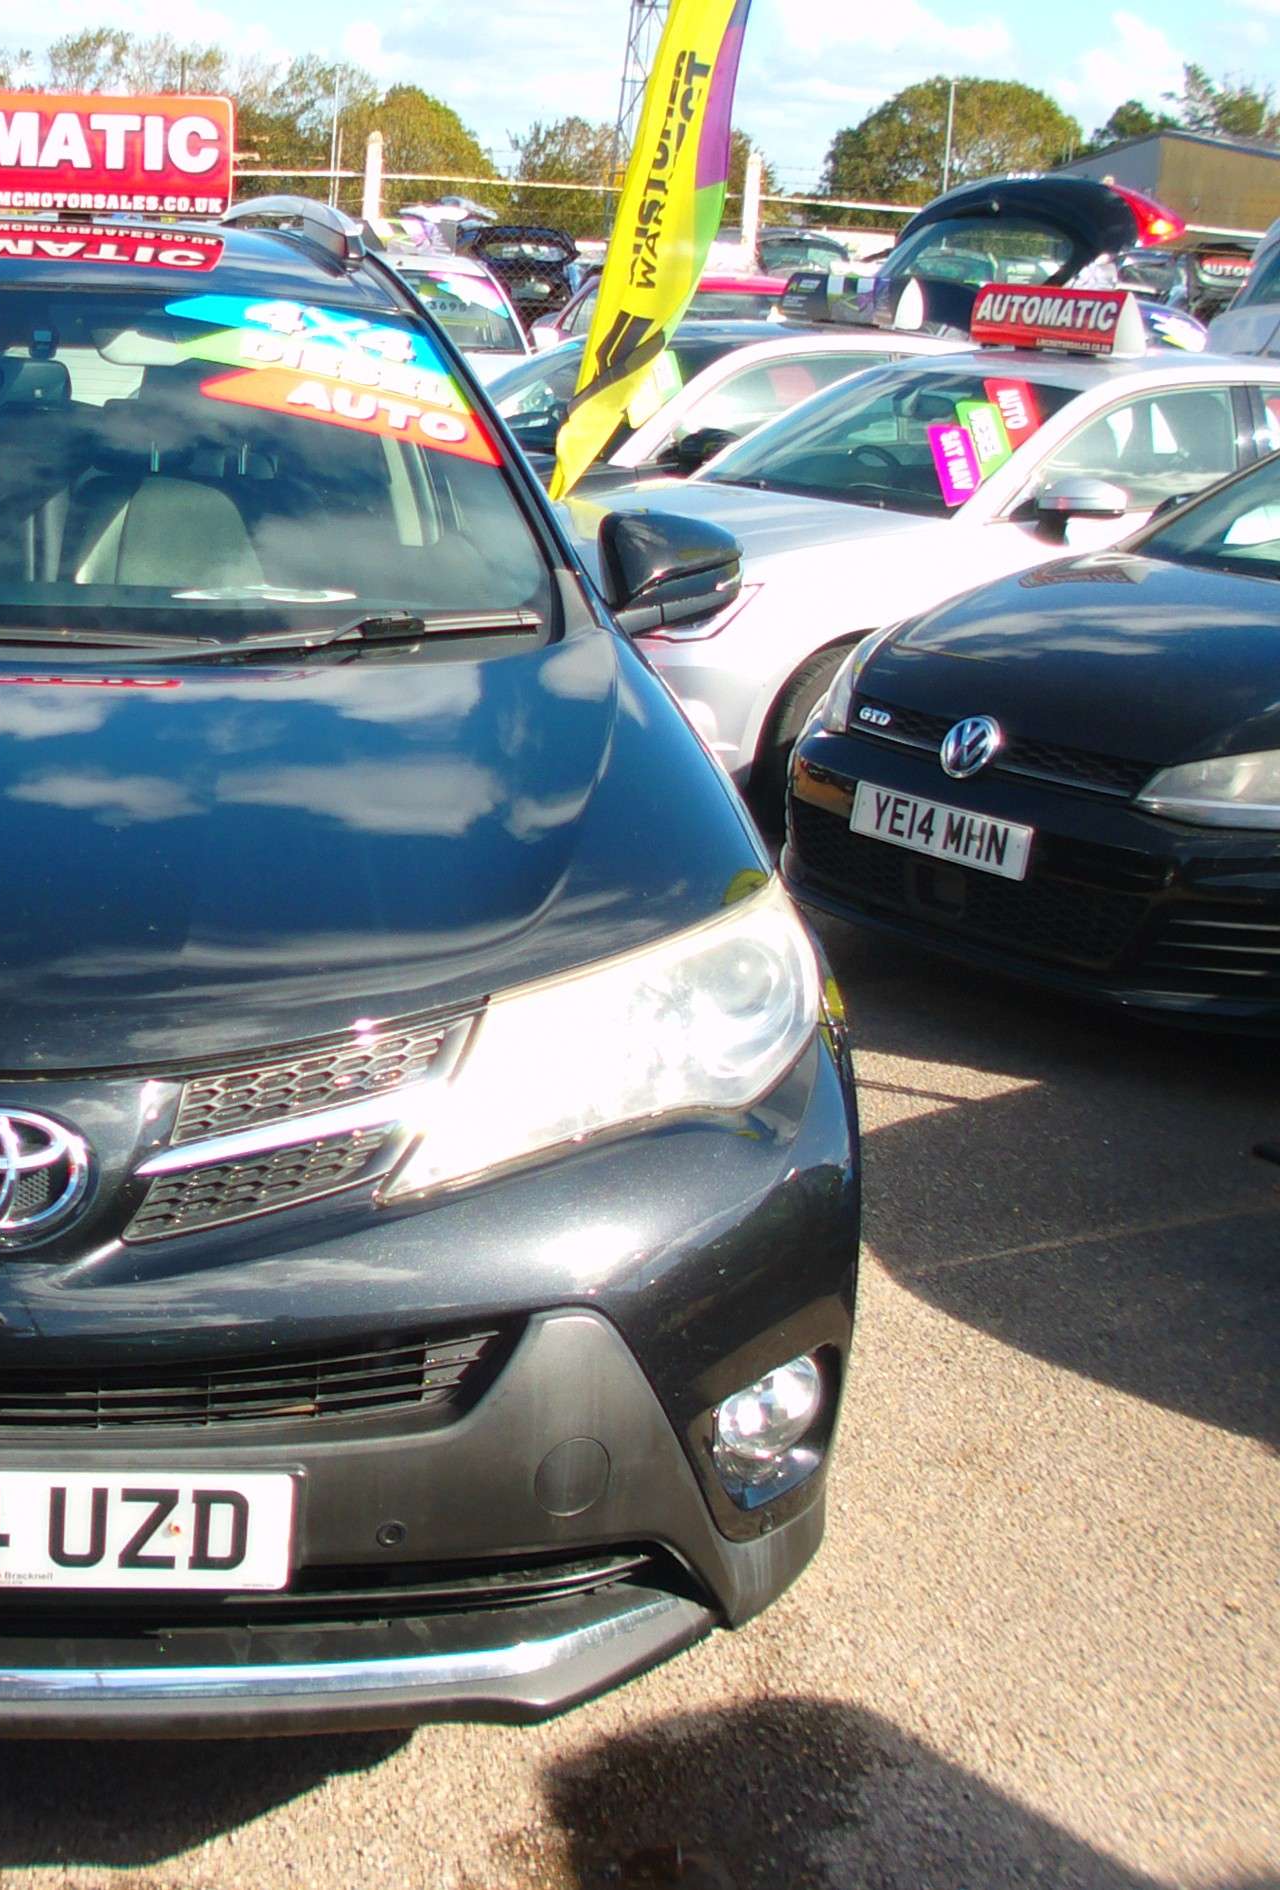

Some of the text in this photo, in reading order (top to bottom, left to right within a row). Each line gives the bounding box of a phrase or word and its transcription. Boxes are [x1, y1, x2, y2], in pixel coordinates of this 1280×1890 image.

[975, 293, 1117, 332] AUTOMATIC
[285, 380, 466, 442] AUTO
[996, 389, 1029, 430] AUTO
[947, 458, 975, 490] NAV
[859, 706, 891, 727] GTD
[875, 791, 1010, 866] YE14 MHN
[47, 1486, 250, 1571] UZD
